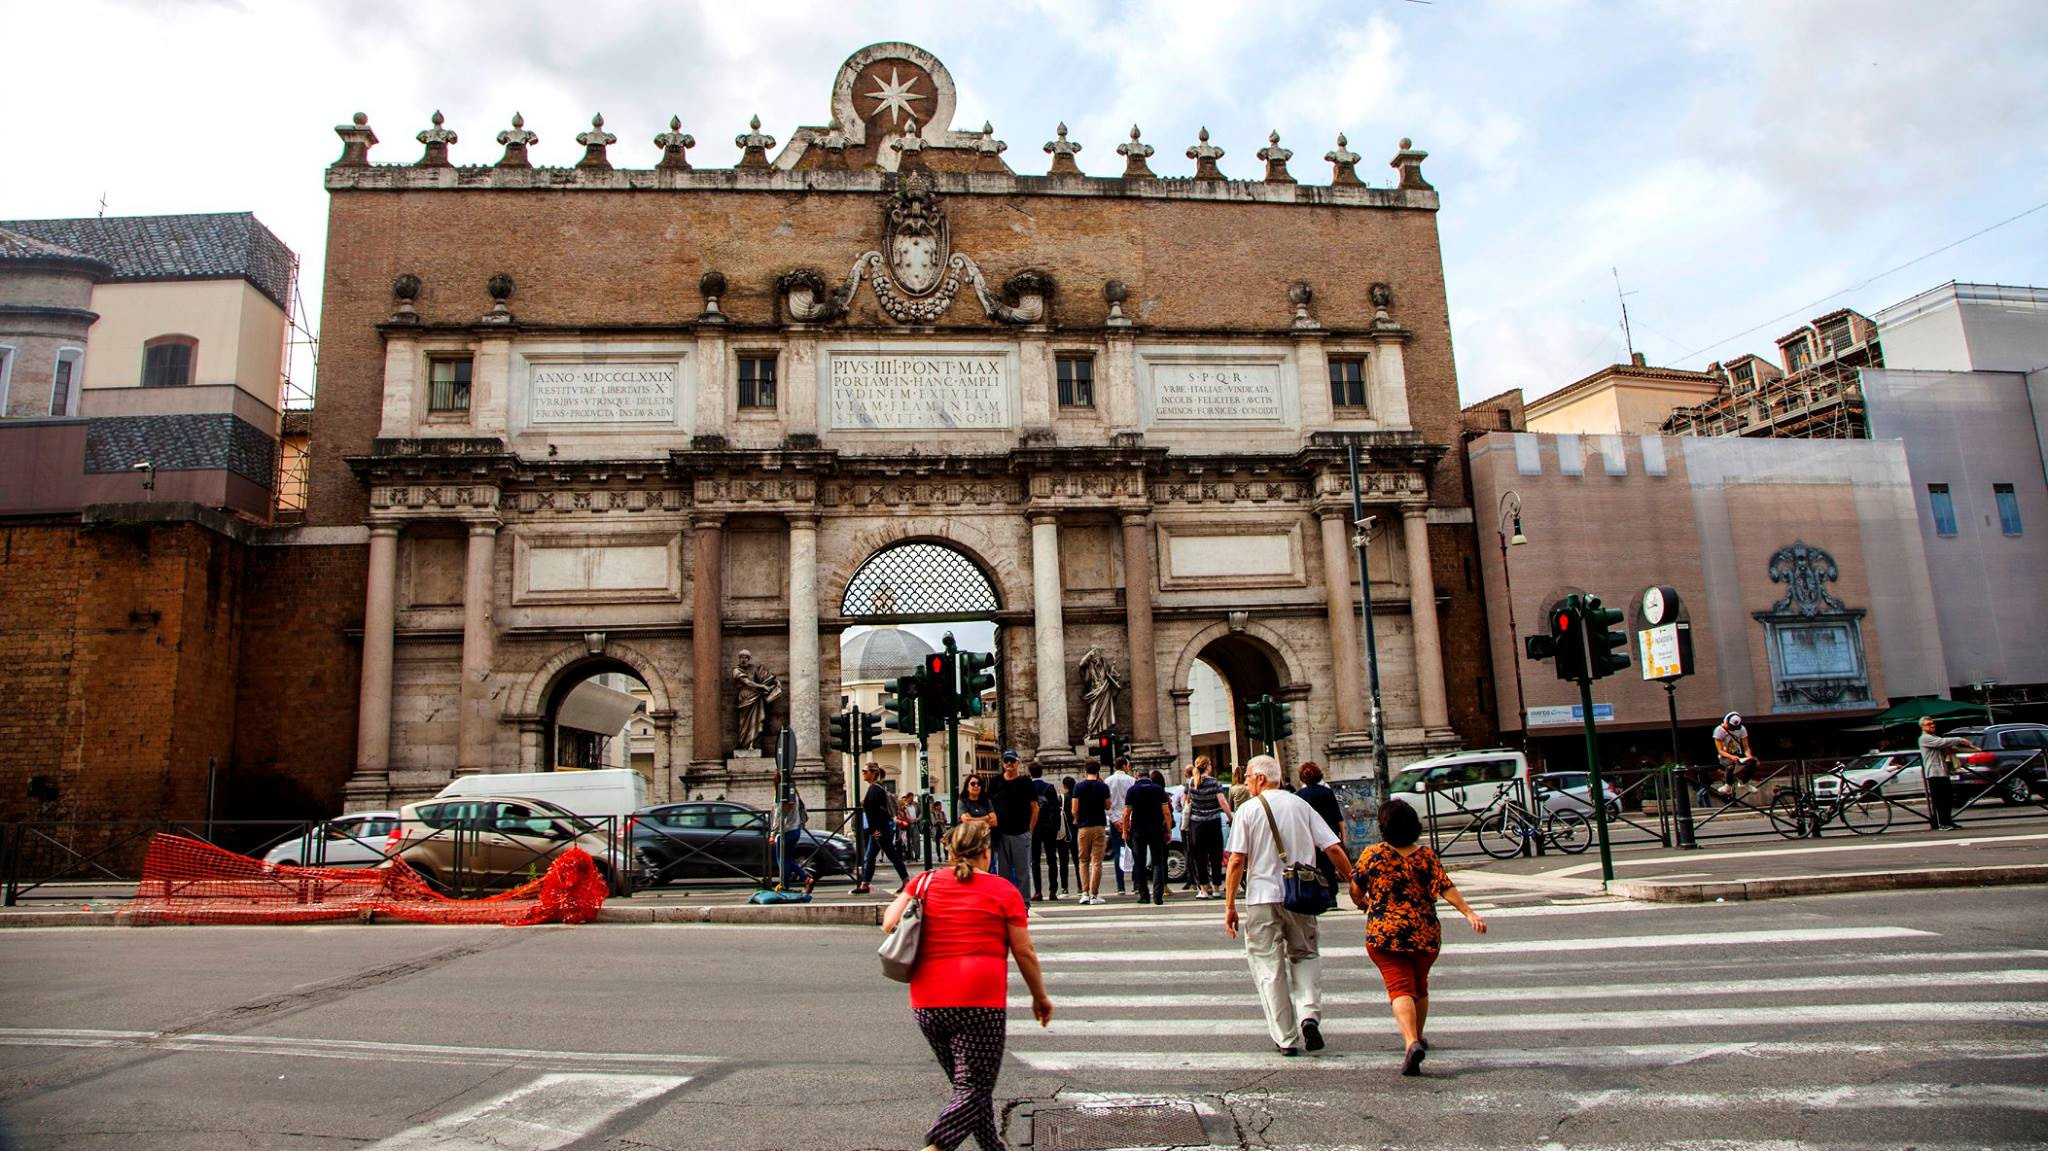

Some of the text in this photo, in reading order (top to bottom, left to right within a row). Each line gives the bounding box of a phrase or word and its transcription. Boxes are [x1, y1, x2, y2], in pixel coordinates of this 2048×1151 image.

[833, 360, 868, 375] PIVS
[902, 361, 951, 374] PONT
[958, 361, 1000, 375] MAX
[536, 372, 673, 383] ANNO MDCCCLXXIX
[834, 377, 999, 387] PORTAM IN HANC AMPLI
[835, 389, 911, 399] TVDINEM
[835, 401, 999, 411] VIAM FLAMINIAM
[928, 413, 977, 424] ANNO
